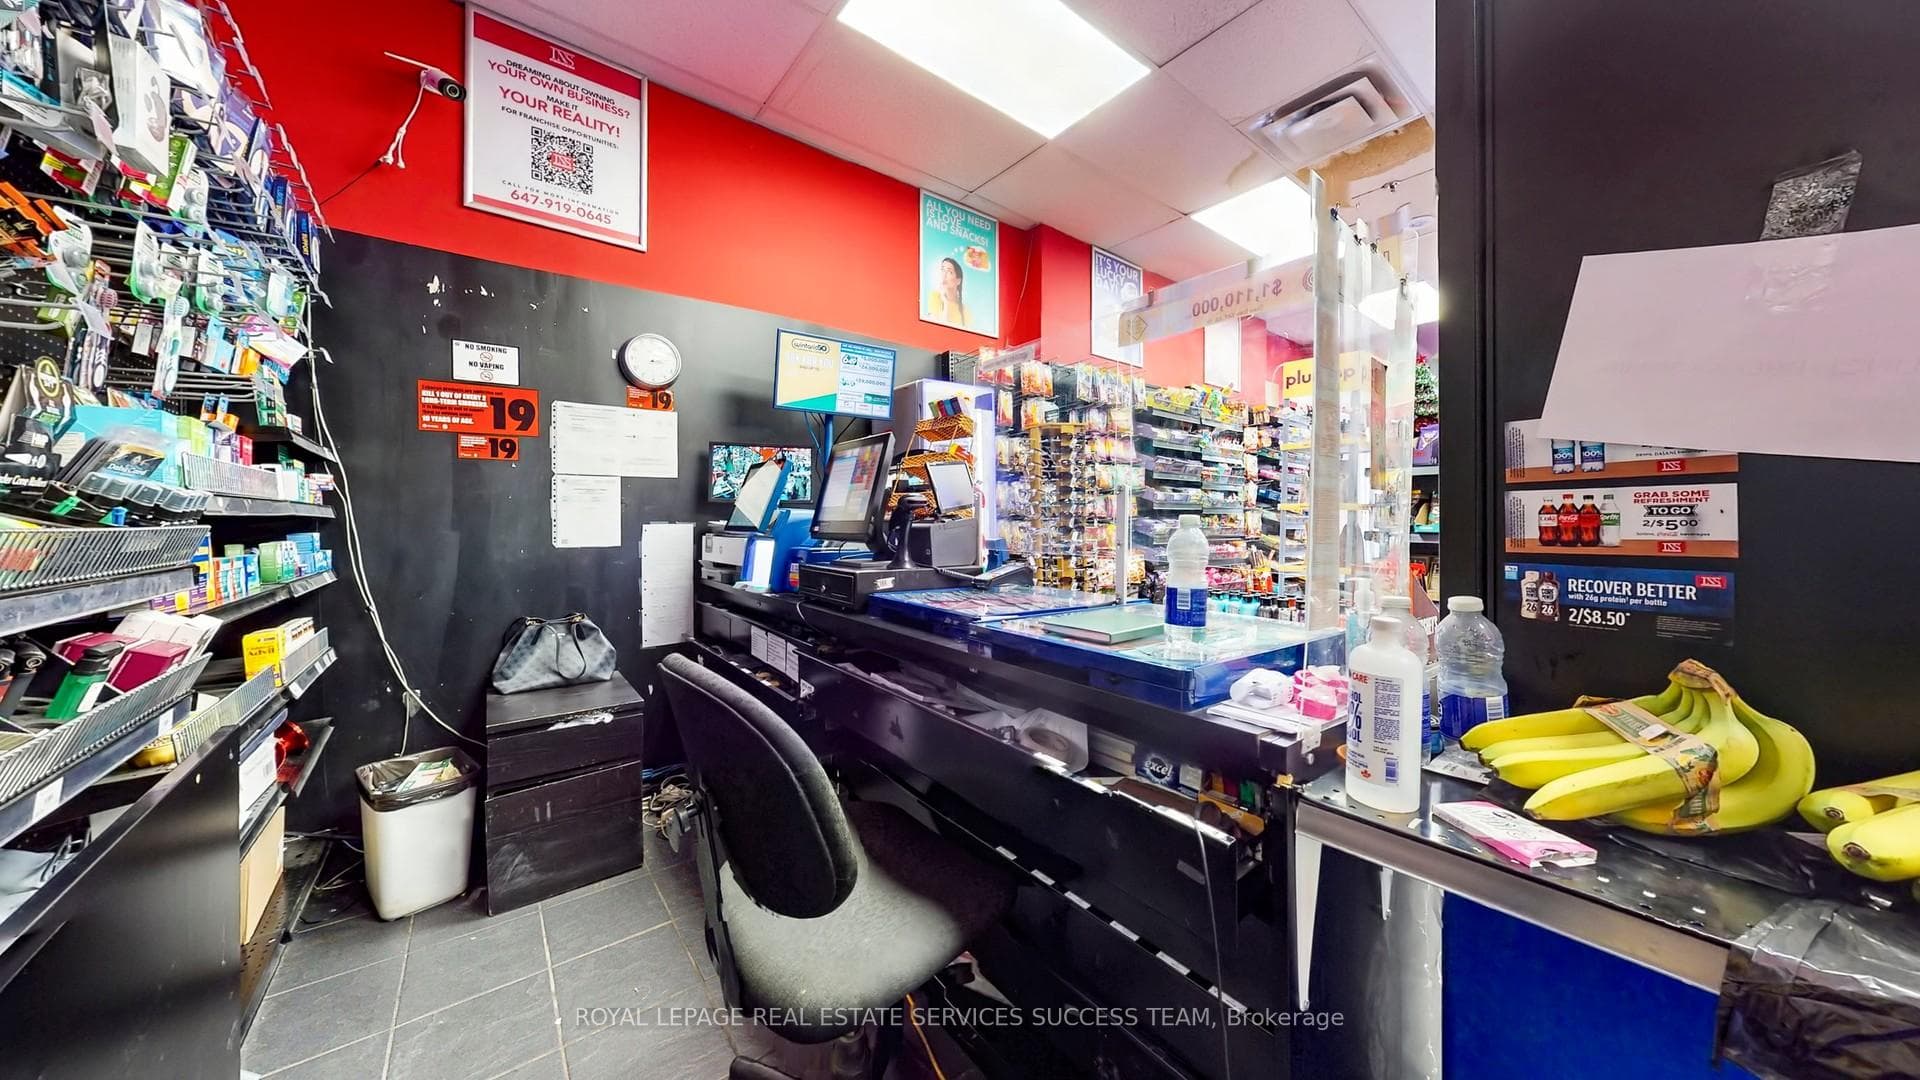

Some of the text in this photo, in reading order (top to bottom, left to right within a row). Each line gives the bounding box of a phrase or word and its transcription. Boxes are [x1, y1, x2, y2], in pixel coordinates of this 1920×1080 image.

[488, 59, 631, 119] YOUR OWN BUSINESS?
[506, 59, 615, 105] DREAMING ABOUT OWNING
[499, 86, 621, 138] YOUR REALITY!
[546, 95, 578, 111] MAKE IT
[501, 106, 518, 117] FOR
[519, 111, 560, 130] FRANCHISE
[502, 179, 522, 189] CALL
[525, 185, 540, 194] FOR
[544, 190, 564, 200] MORE
[510, 189, 612, 225] 647-919-0645
[926, 199, 991, 231] ALL YOU NEED
[926, 208, 961, 228] IS LOVE
[926, 218, 989, 246] AND SNACKS!
[1095, 254, 1139, 282] IT'S YOUR
[1095, 265, 1125, 285] LUCKY
[476, 345, 507, 354] SMOKING
[479, 361, 504, 370] VAPING
[1285, 370, 1312, 390] plu
[651, 391, 672, 409] 19
[490, 397, 536, 431] 19
[489, 438, 517, 458] 19
[1633, 490, 1710, 499] GRAB SOME
[1651, 506, 1691, 515] TO GO
[1567, 578, 1632, 596] RECOVER
[1636, 582, 1697, 600] BETTER
[1526, 602, 1537, 612] 26
[1541, 604, 1554, 615] 26
[1585, 593, 1598, 602] 26g
[1644, 598, 1668, 607] bottle
[1352, 671, 1369, 684] CARE
[1143, 757, 1172, 777] excel
